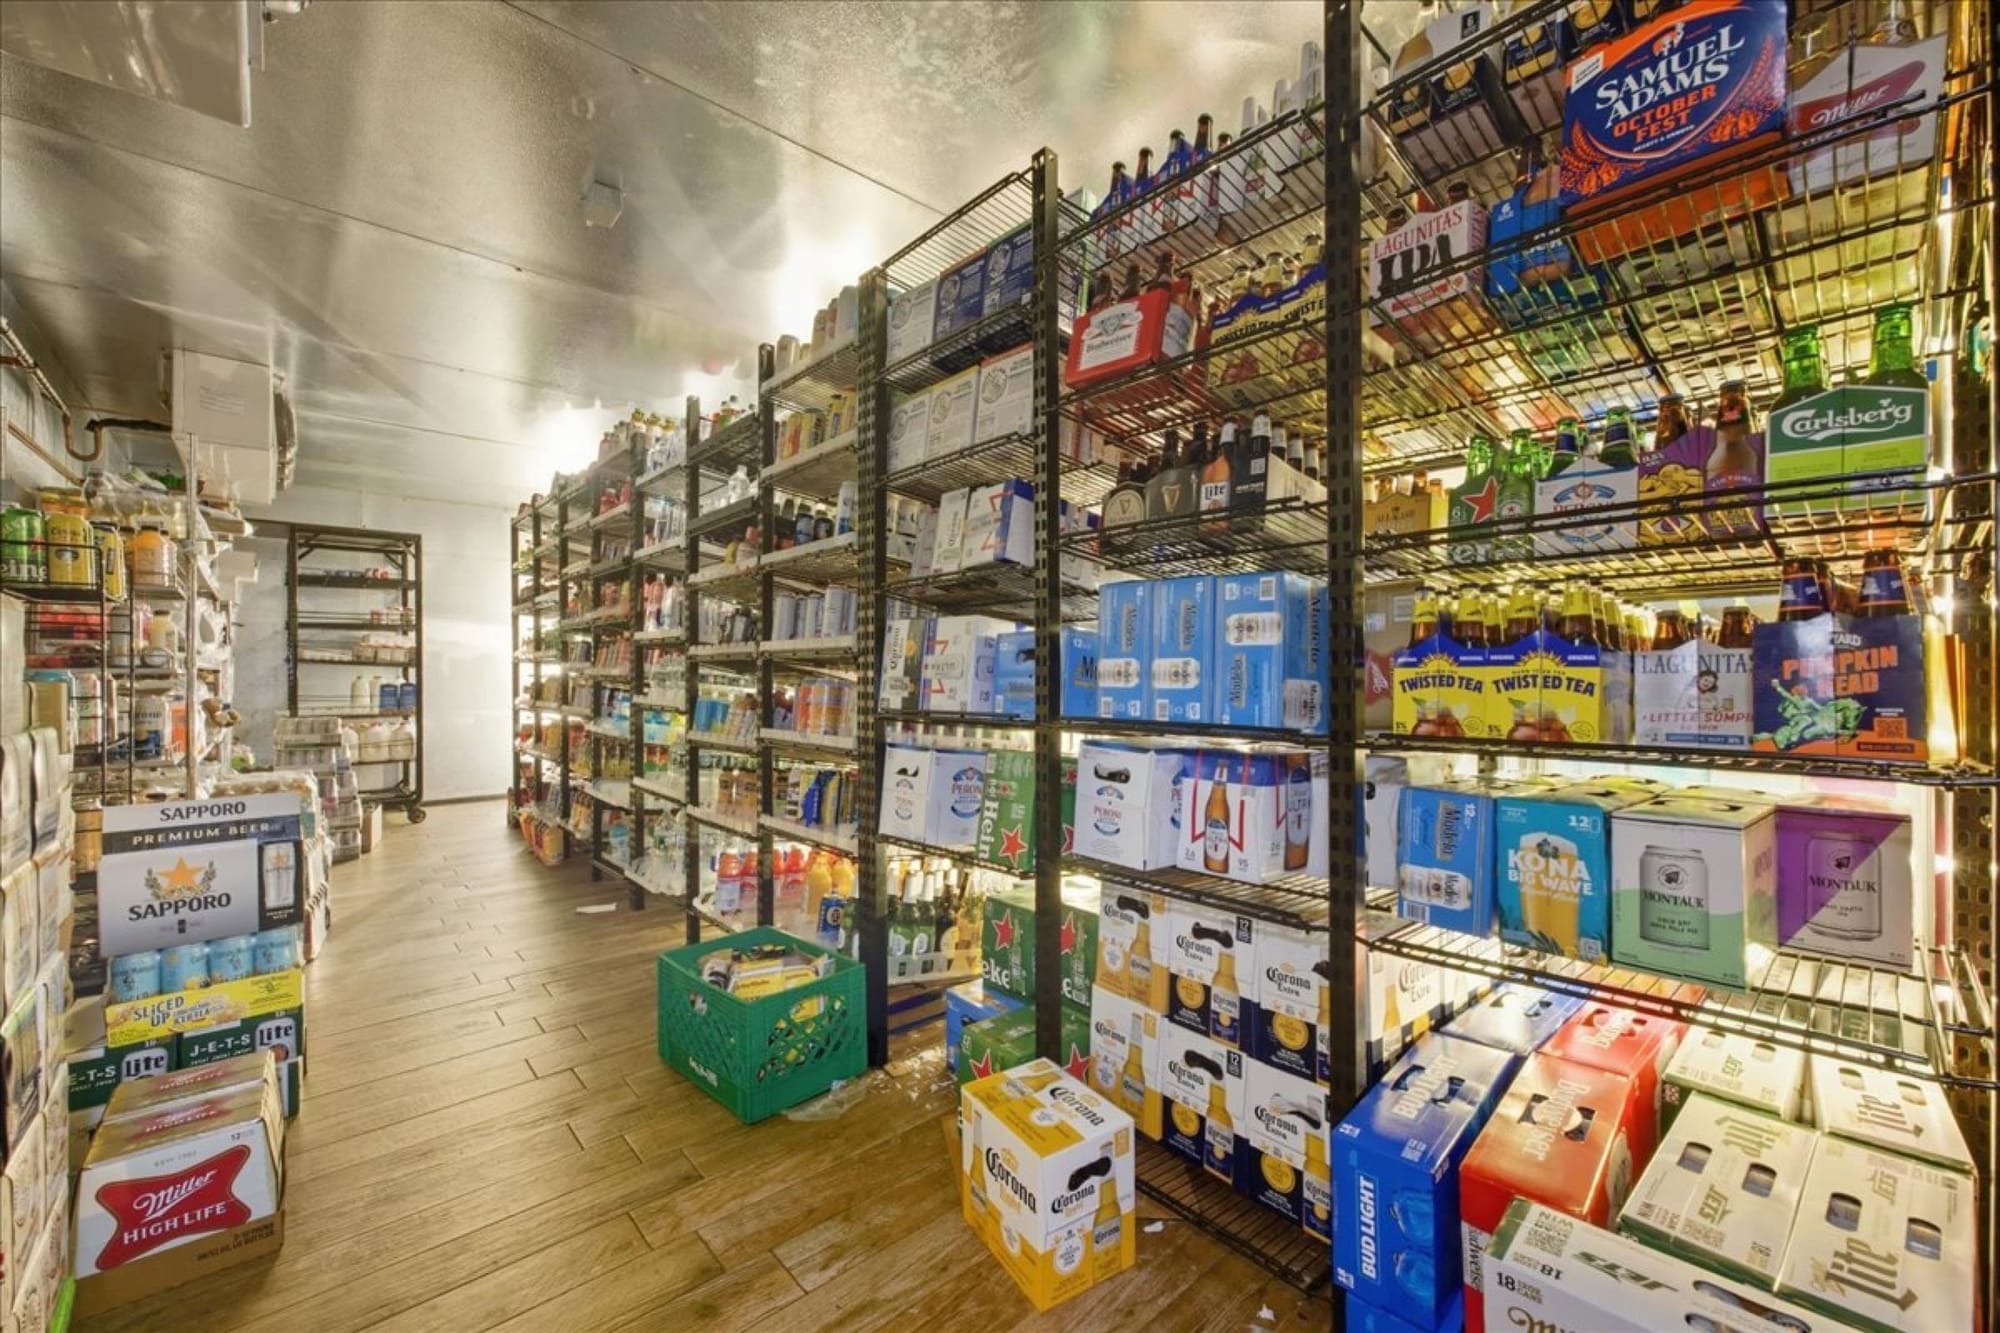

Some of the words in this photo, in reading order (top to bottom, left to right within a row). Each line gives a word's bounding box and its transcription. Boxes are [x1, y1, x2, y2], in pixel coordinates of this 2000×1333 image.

[1597, 25, 1745, 109] SAMUEL
[1605, 56, 1729, 129] ADAMS
[1613, 84, 1717, 137] OCTOBER
[1635, 110, 1691, 142] FEST
[1373, 207, 1463, 259] LAGUNITAS
[1782, 399, 1913, 440] Carlsberg
[1205, 486, 1225, 500] Lite
[1642, 653, 1754, 674] LAGUNITA
[1783, 645, 1898, 680] PUMPKIN
[1399, 674, 1457, 694] TWISTED
[1458, 676, 1484, 695] TEA
[1492, 673, 1563, 694] TWISTED
[1565, 677, 1596, 697] TEA
[1815, 671, 1880, 699] HEAD
[1650, 713, 1698, 722] LITTLE
[159, 801, 246, 822] SAPPORO
[1568, 815, 1590, 827] 12
[132, 827, 220, 846] PREMIUM
[228, 823, 270, 835] BEER
[1507, 848, 1590, 880] KONA
[1508, 869, 1536, 886] BIG
[1542, 875, 1594, 896] WAVE
[1809, 874, 1878, 893] MONTAUK
[128, 892, 232, 921] SAPPORO
[1643, 890, 1705, 909] MONTAUK
[1103, 903, 1135, 924] Corona
[1239, 919, 1249, 929] 12
[1176, 935, 1213, 955] Corona
[1184, 950, 1203, 961] Extra
[1266, 967, 1311, 991] Corona
[1277, 982, 1300, 997] Extra
[134, 995, 184, 1021] SLICED
[150, 1010, 171, 1028] UP
[258, 1023, 293, 1046] Lite
[1095, 1021, 1126, 1044] Corona
[190, 1033, 251, 1058] J-E-T-S
[125, 1054, 165, 1078] Lite
[1230, 1054, 1240, 1064] 12
[1168, 1060, 1204, 1085] Corona
[1177, 1074, 1196, 1090] Extra
[1049, 1086, 1105, 1127] Corona
[1392, 1089, 1432, 1119] BUD
[1255, 1105, 1298, 1135] Corona
[1265, 1123, 1287, 1140] Extra
[986, 1147, 1037, 1214] Corona
[133, 1170, 218, 1225] Miller
[1051, 1184, 1096, 1214] Corona
[1359, 1176, 1376, 1238] LIGHT
[1698, 1183, 1734, 1224] JETS
[123, 1218, 178, 1244] HIGH
[184, 1201, 227, 1225] LIFE
[1359, 1241, 1378, 1280] BUD
[1539, 1264, 1564, 1281] 18
[1496, 1272, 1516, 1292] 18
[1824, 1238, 1919, 1312] Lite
